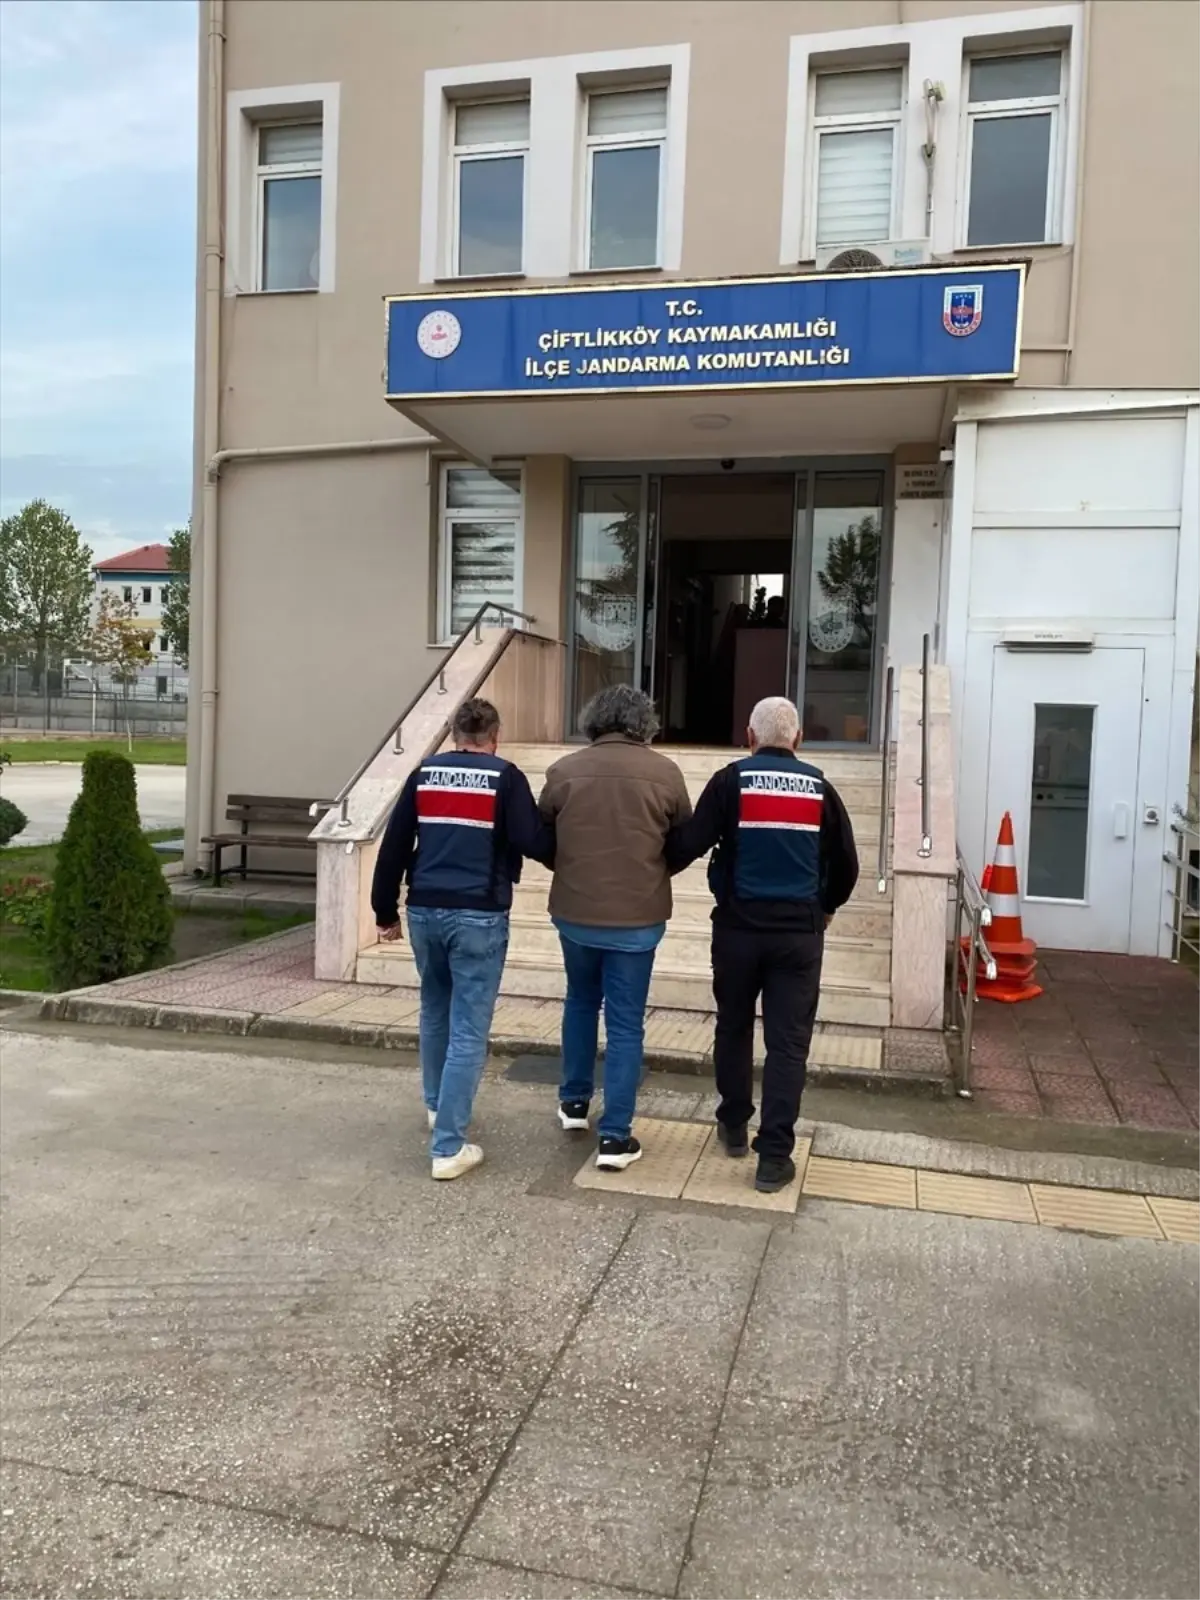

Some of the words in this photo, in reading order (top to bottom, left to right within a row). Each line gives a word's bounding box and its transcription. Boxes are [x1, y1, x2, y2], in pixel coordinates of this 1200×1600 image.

[665, 300, 703, 317] T.C.
[538, 326, 661, 353] ÇİFTLİKKÖY
[667, 317, 836, 344] KAYMAKAMLIĞI
[525, 357, 570, 379] İLÇE
[576, 355, 690, 375] JANDARMA
[697, 345, 850, 370] KOMUTANLIĞI
[425, 770, 489, 789] JANDARMA
[748, 775, 817, 794] JANDARMA
